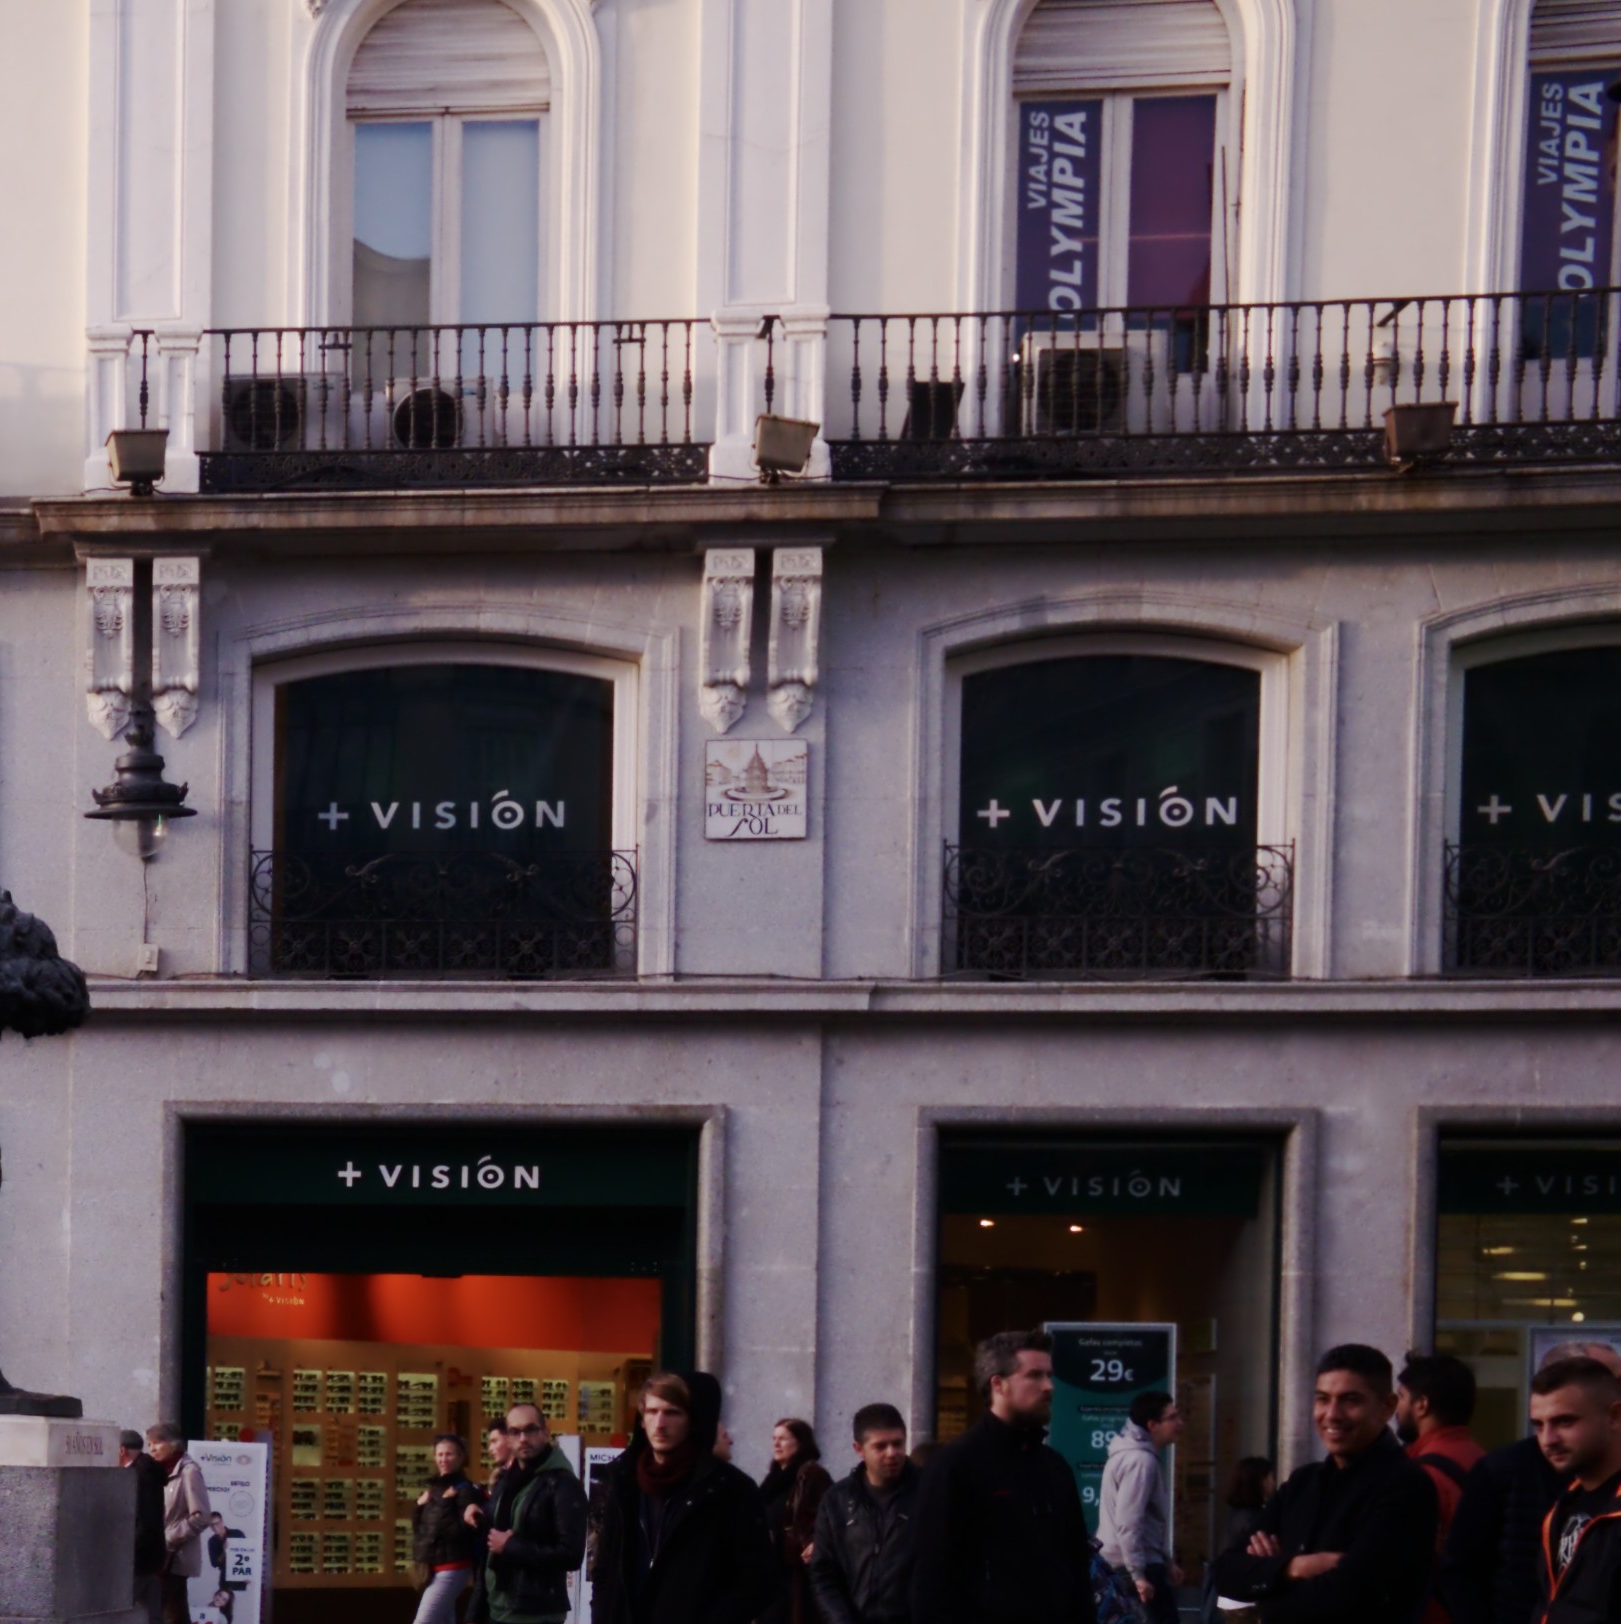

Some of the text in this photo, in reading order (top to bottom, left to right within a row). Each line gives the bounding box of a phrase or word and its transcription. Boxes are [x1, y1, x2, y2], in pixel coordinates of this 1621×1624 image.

[1538, 83, 1563, 185] VIAJES
[1028, 112, 1049, 209] VIAJES
[1558, 82, 1604, 298] OLYMPIA
[1048, 111, 1087, 319] OLYMPIA
[370, 789, 565, 830] VISIÓN
[708, 802, 802, 818] PUERTA DEL
[1032, 785, 1237, 828] VISIÓN
[726, 817, 779, 837] SOL
[378, 1155, 539, 1189] VISIÓN
[1043, 1169, 1181, 1198] VISIÓN
[1089, 1359, 1134, 1382] 29€
[232, 1567, 252, 1576] PAR
